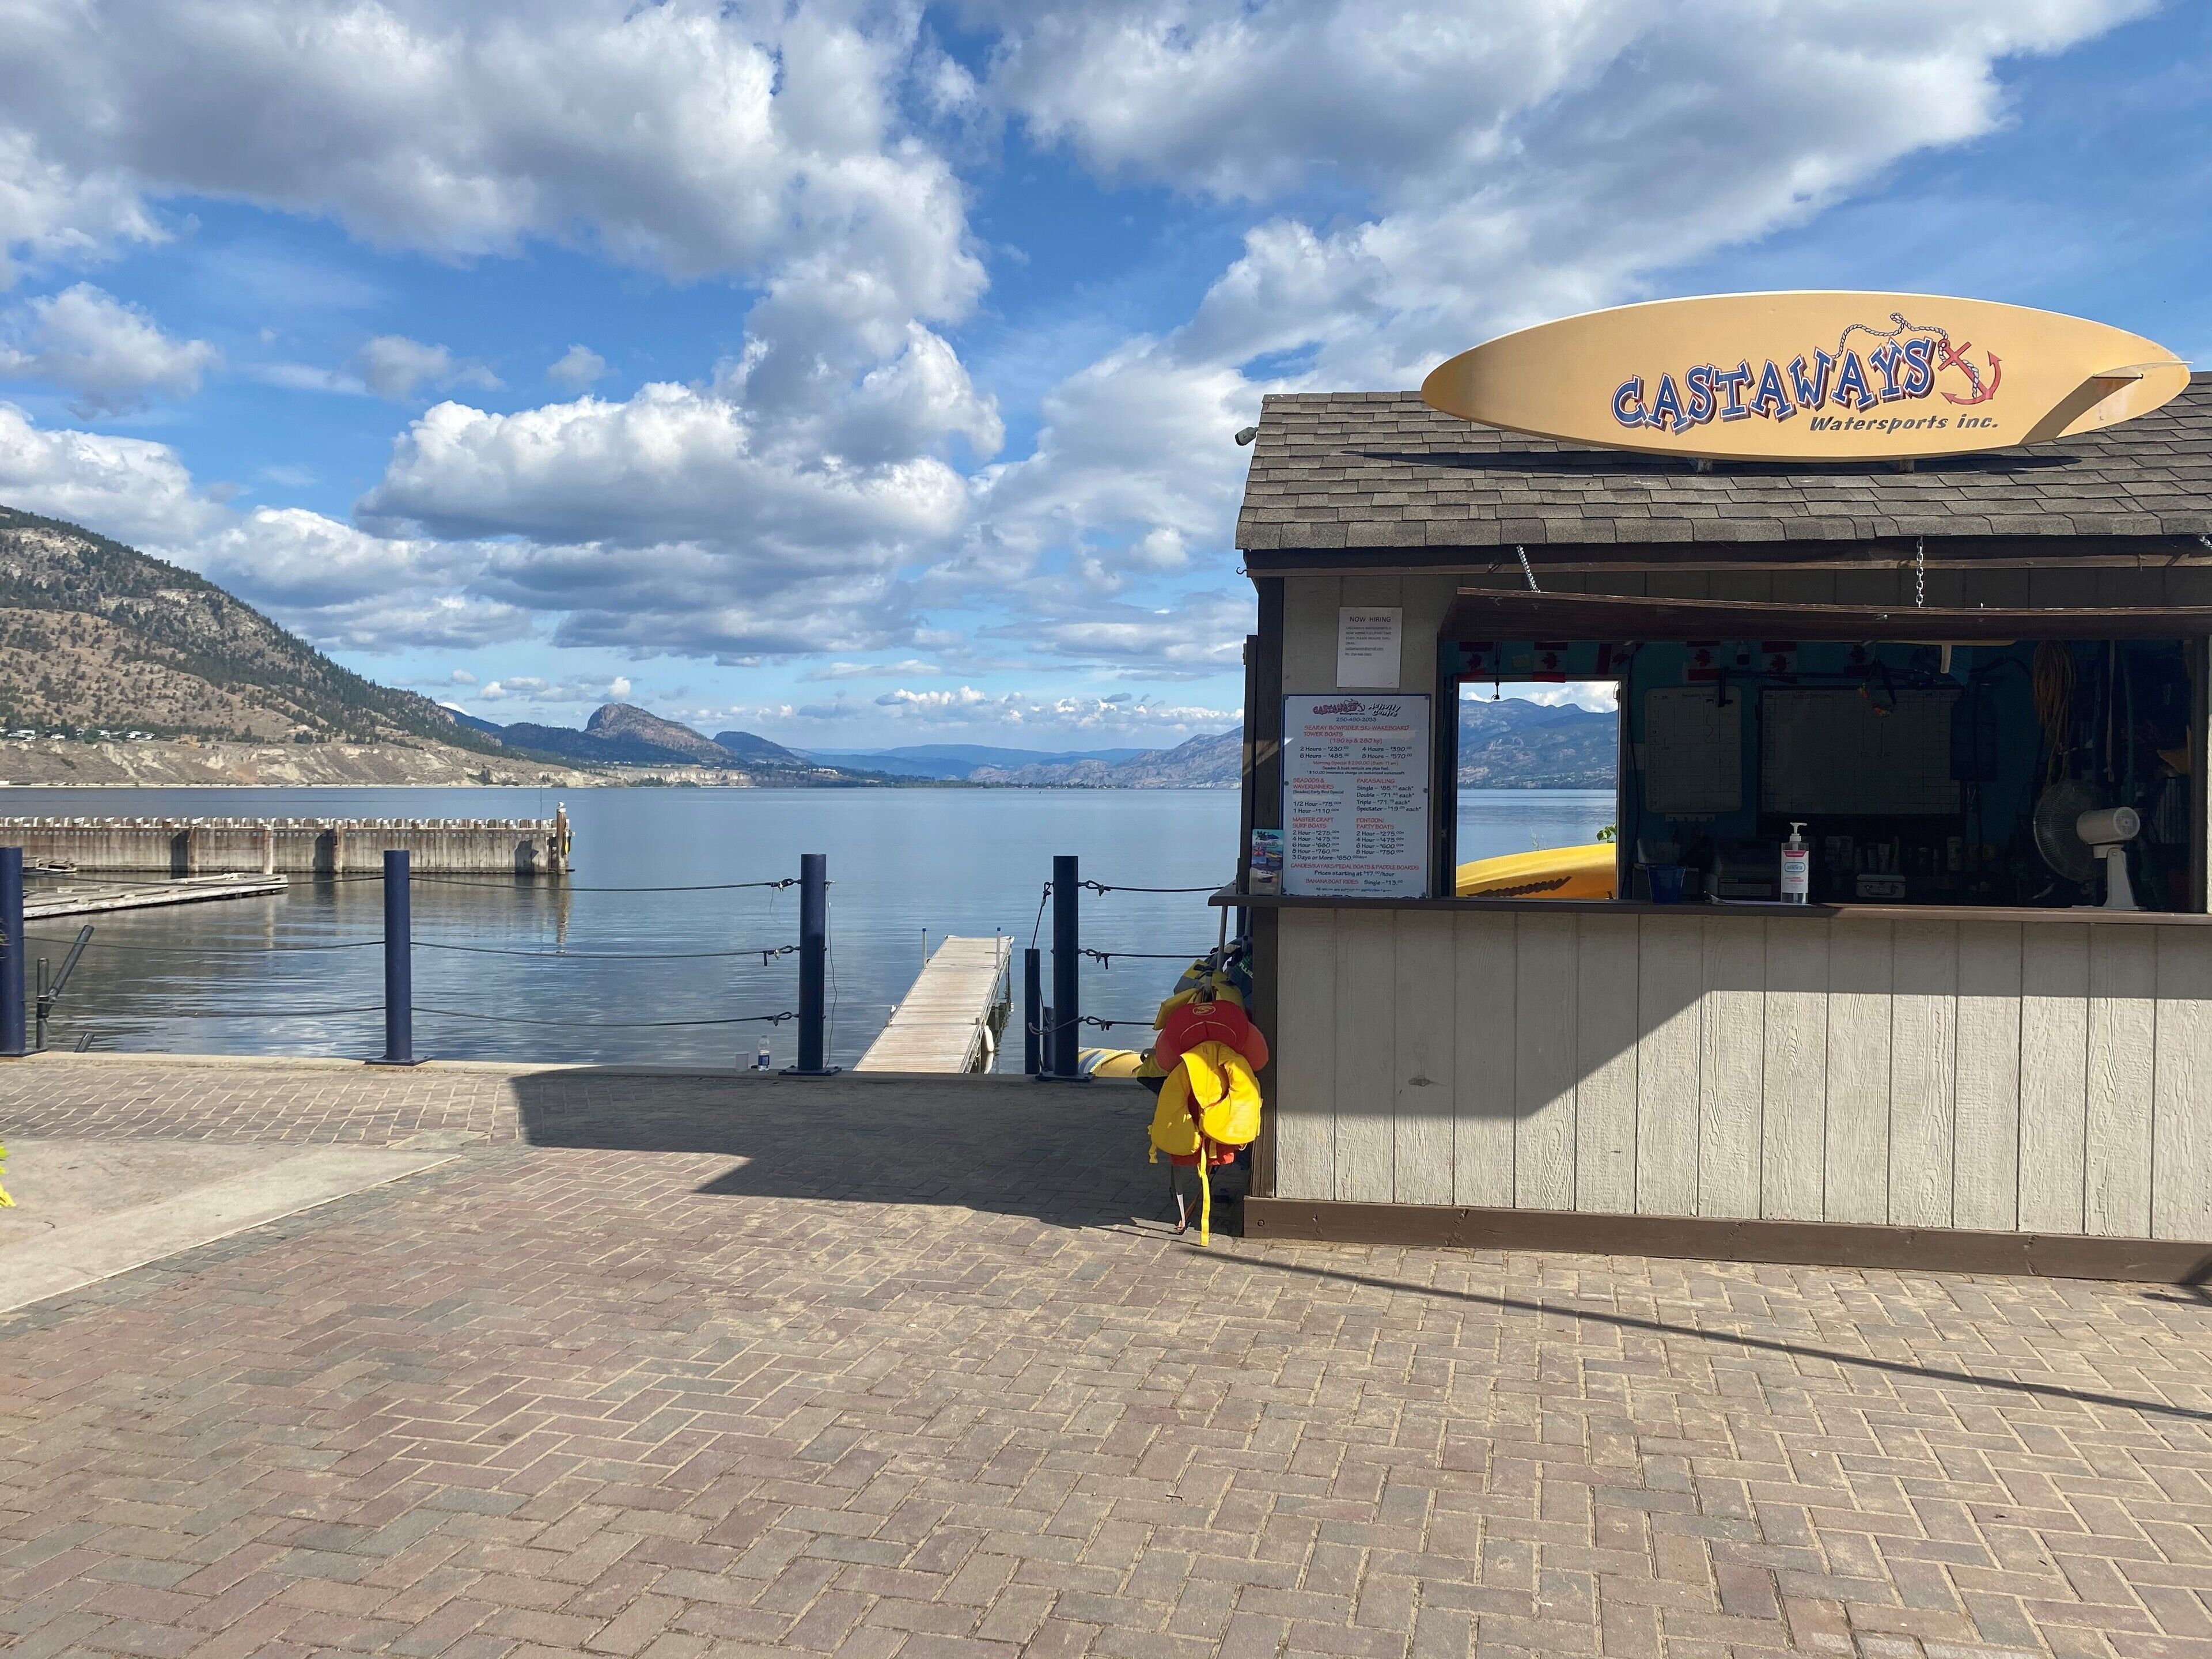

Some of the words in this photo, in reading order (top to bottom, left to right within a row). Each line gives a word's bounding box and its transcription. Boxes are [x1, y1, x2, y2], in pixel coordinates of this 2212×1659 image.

[1611, 336, 1937, 436] CASTAWAYS
[1809, 414, 1949, 434] Watersports
[1956, 413, 1999, 429] inc.
[1368, 703, 1401, 712] Activity
